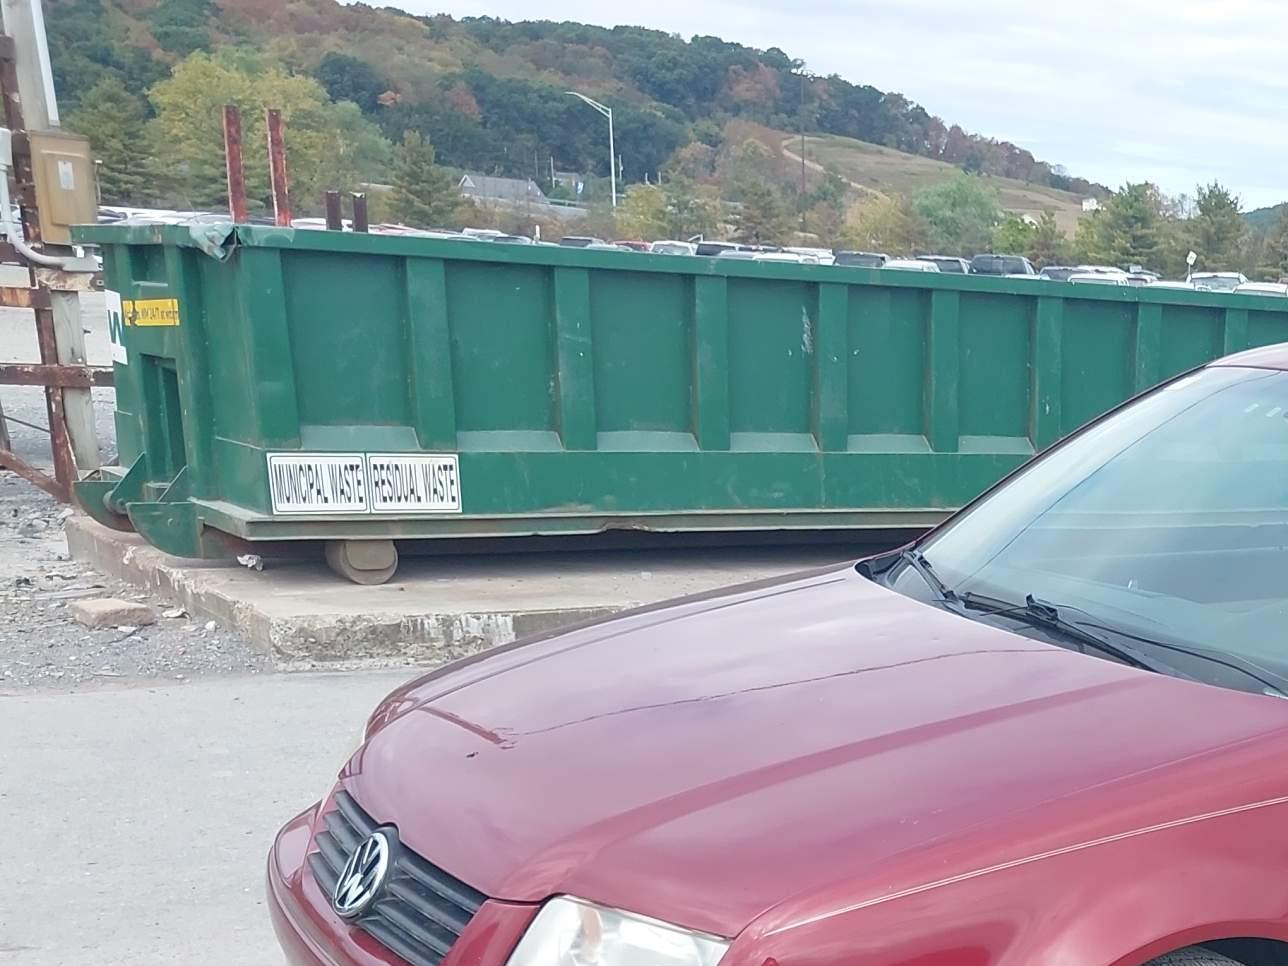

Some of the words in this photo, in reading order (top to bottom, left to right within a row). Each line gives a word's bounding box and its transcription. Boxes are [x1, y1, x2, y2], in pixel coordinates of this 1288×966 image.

[273, 463, 329, 504] MUNICIPAL
[327, 463, 364, 503] WASTE
[372, 463, 422, 504] RESIDUAL
[421, 463, 457, 503] WASTE
